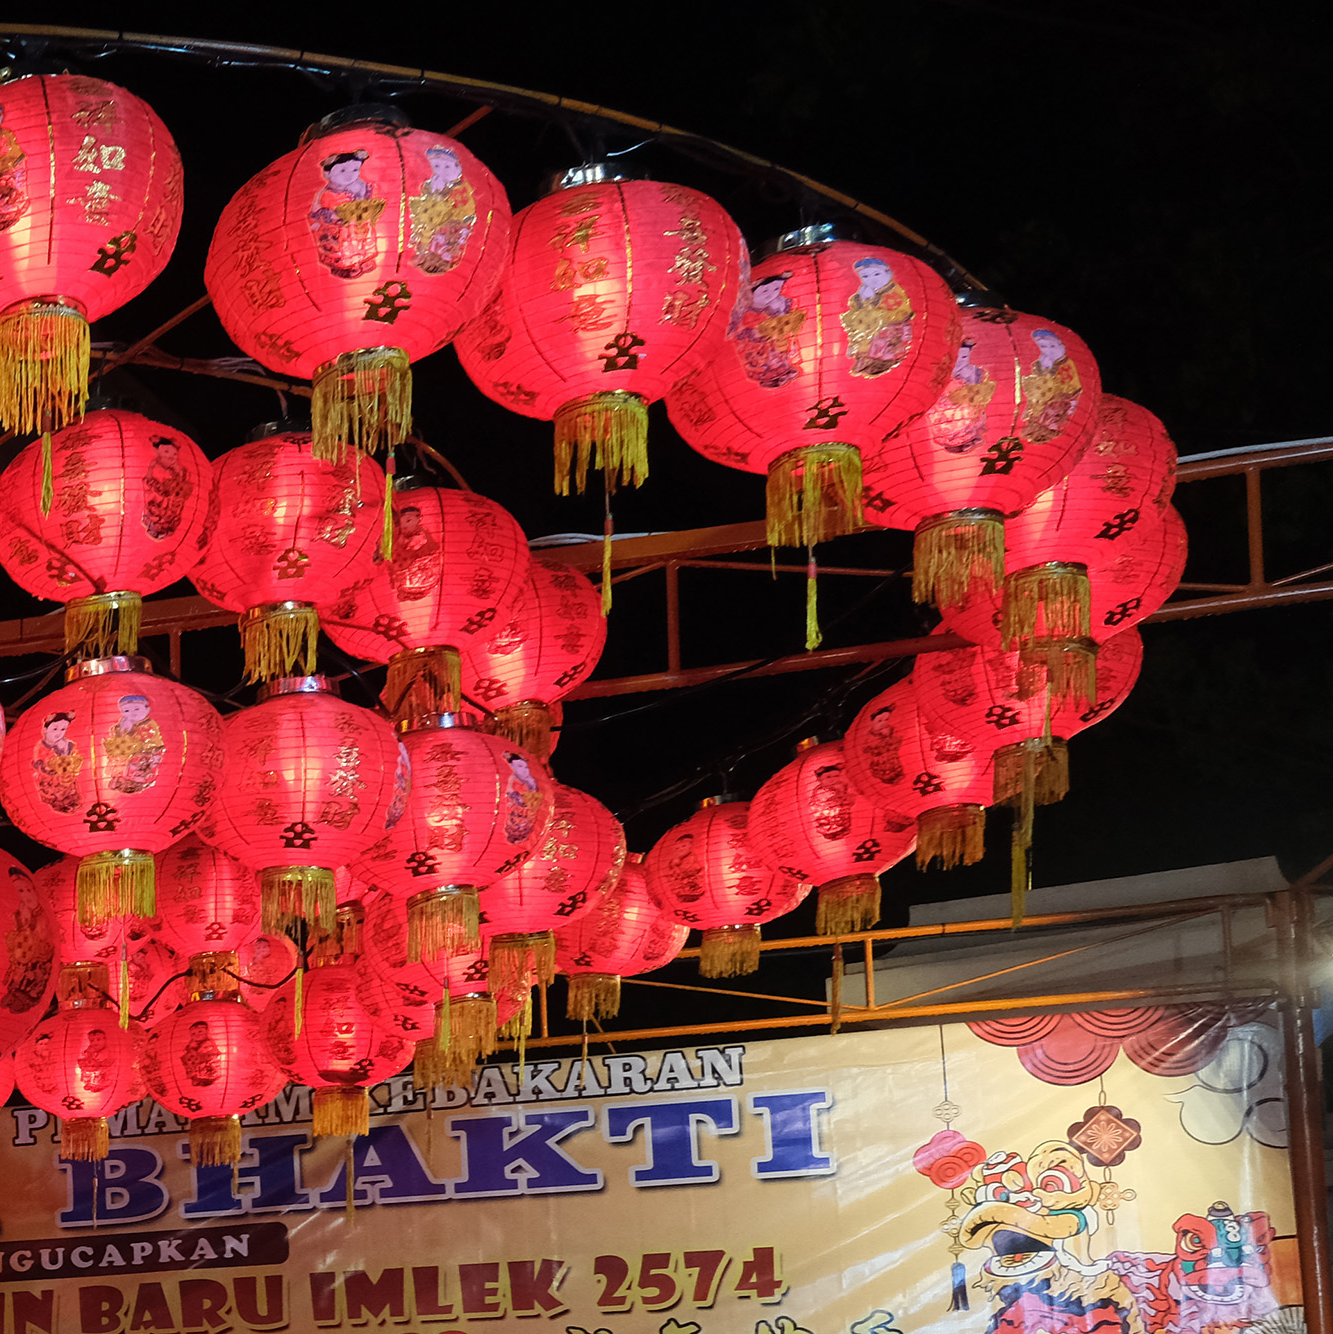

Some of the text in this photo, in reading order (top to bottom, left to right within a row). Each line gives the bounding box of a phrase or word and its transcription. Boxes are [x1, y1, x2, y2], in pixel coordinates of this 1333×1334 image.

[56, 1088, 838, 1230] BHAKTI
[310, 1258, 571, 1327] IMLEK
[594, 1247, 790, 1314] 2574
